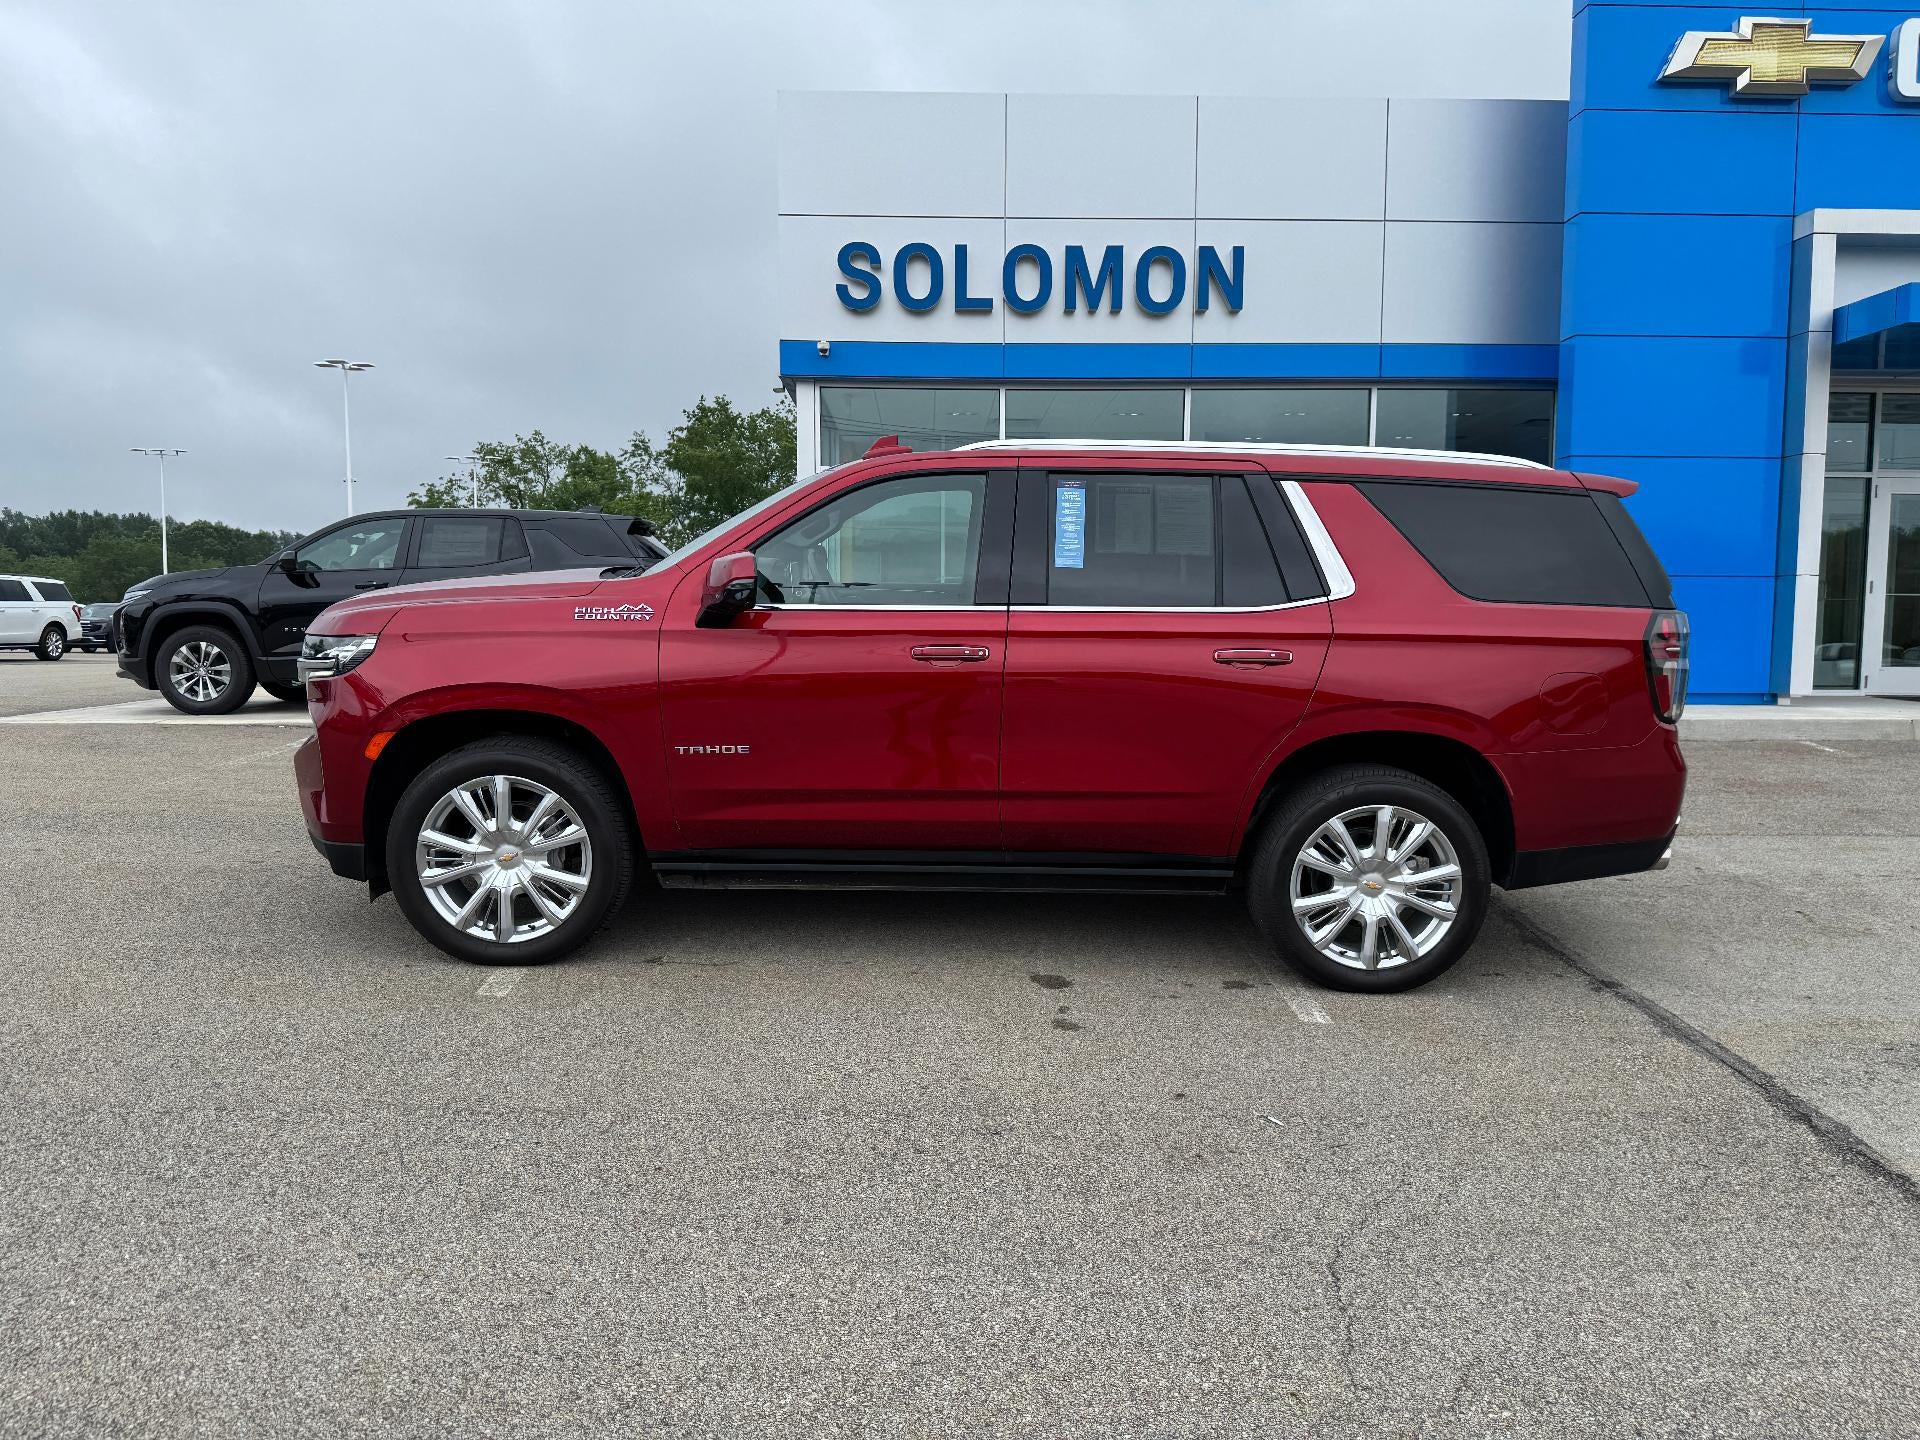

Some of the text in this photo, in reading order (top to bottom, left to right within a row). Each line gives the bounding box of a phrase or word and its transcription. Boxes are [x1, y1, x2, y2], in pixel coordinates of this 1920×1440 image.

[835, 241, 1245, 314] SOLOMON
[574, 613, 653, 621] COUNTRY
[674, 745, 750, 755] TAHOE
